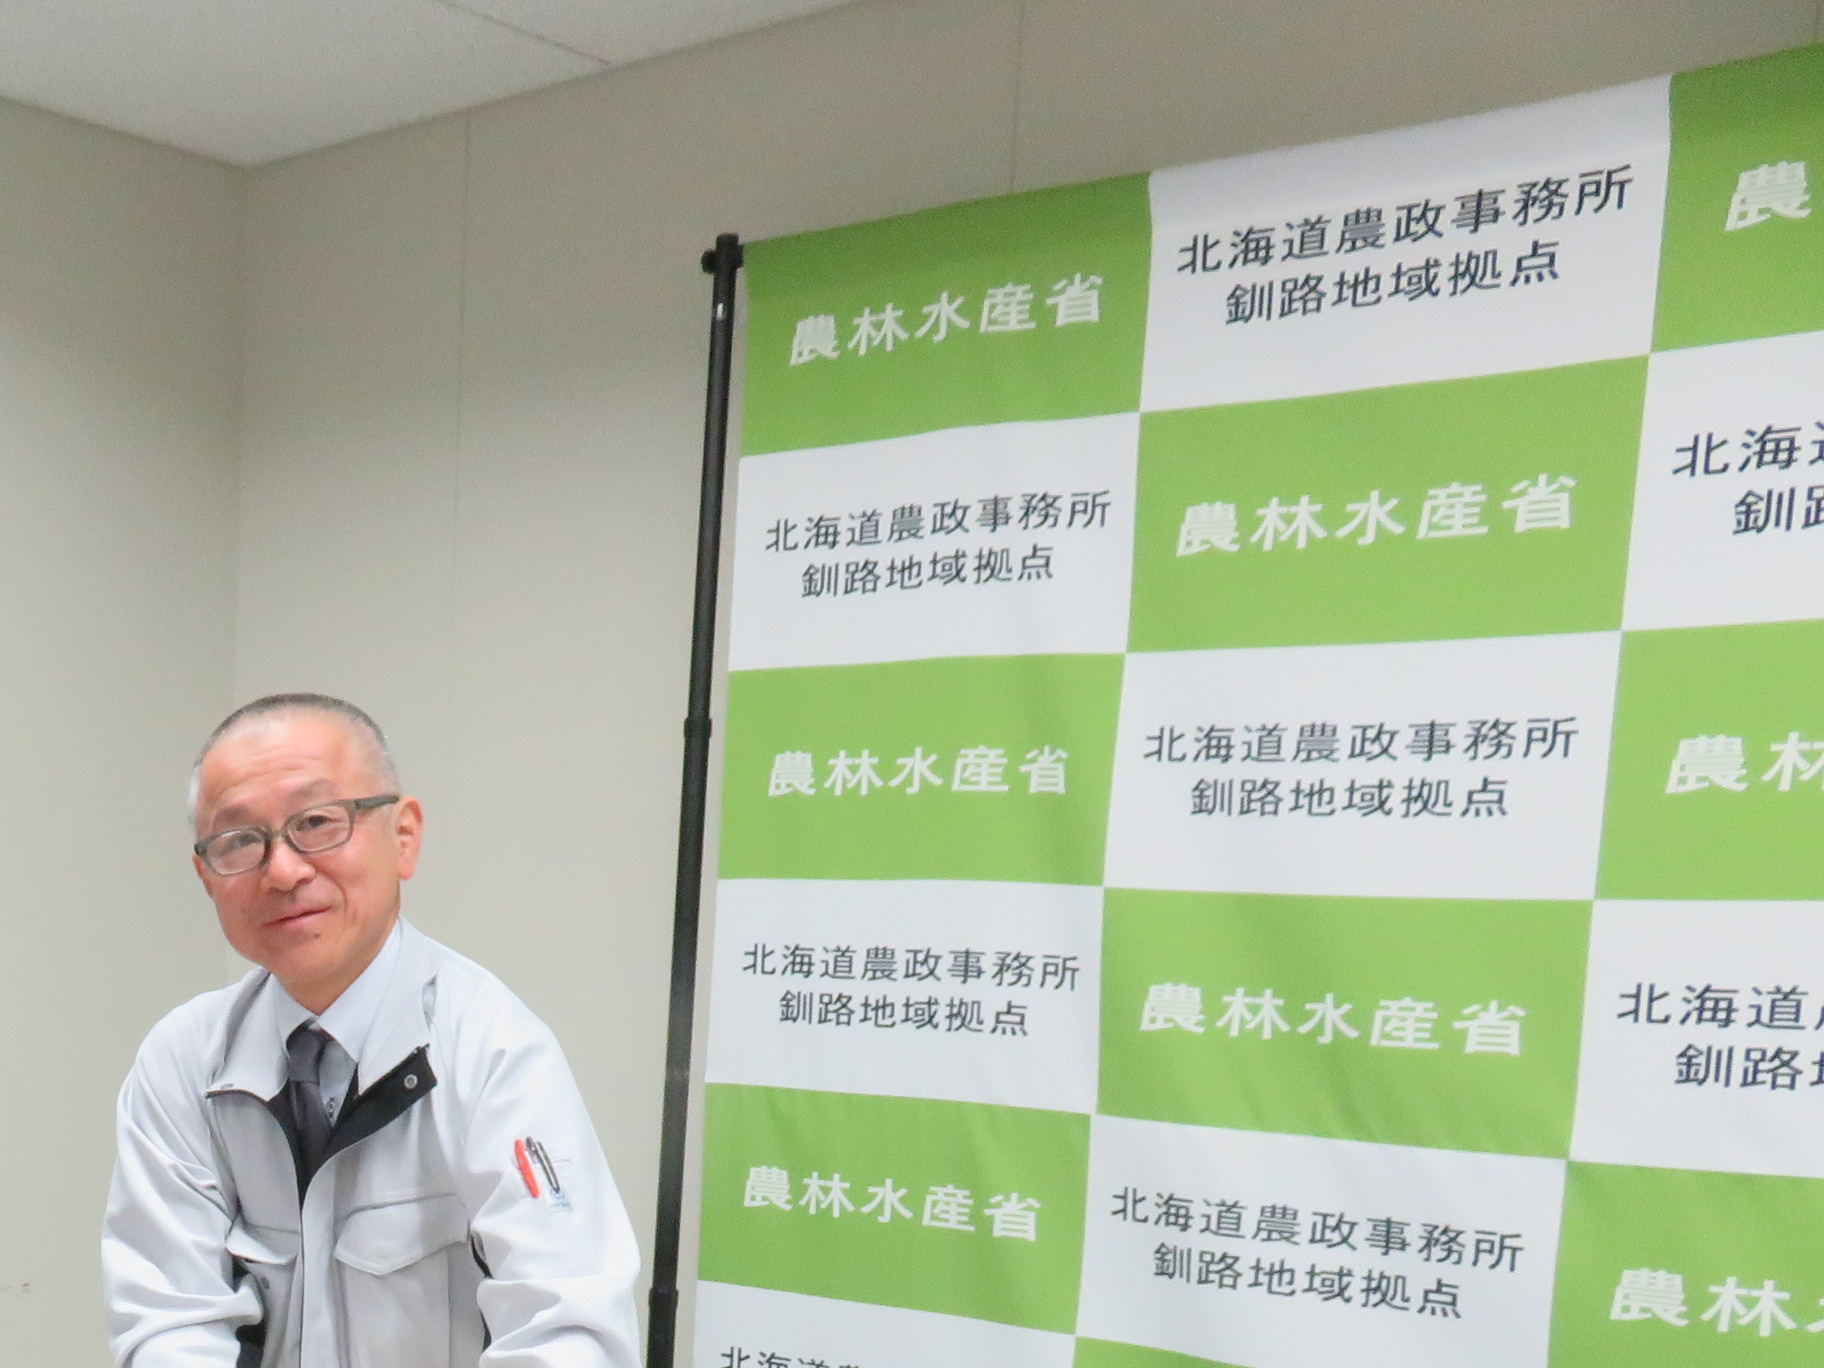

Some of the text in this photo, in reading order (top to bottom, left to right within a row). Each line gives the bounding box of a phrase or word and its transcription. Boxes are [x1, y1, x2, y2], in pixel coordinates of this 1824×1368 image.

[1177, 164, 1633, 274] 北海道農政事務所
[1724, 160, 1812, 231] 農
[1226, 240, 1559, 324] 釧路地域拠点
[790, 273, 1104, 366] 農林水産省
[1672, 421, 1824, 477] 北海
[766, 490, 1111, 552] 北海道農政事務所
[1176, 474, 1577, 556] 農林水産省
[802, 544, 1052, 597] 釧路地域拠点
[768, 745, 1069, 797] 農林水産省
[1144, 717, 1578, 763] 北海道農政事務所
[1191, 777, 1507, 818] 釧路地域拠点
[743, 944, 1080, 991] 北海道農政事務所
[780, 990, 1027, 1036] 釧路地域拠点
[1140, 982, 1528, 1056] 農林水産省
[1617, 983, 1824, 1030] 北海道
[1675, 1044, 1824, 1091] 釧路
[743, 1165, 1041, 1242] 農林水産省
[1111, 1187, 1523, 1272] 北海道農政事務所
[1154, 1242, 1461, 1319] 釧路地域拠点
[1609, 1268, 1824, 1336] 農林
